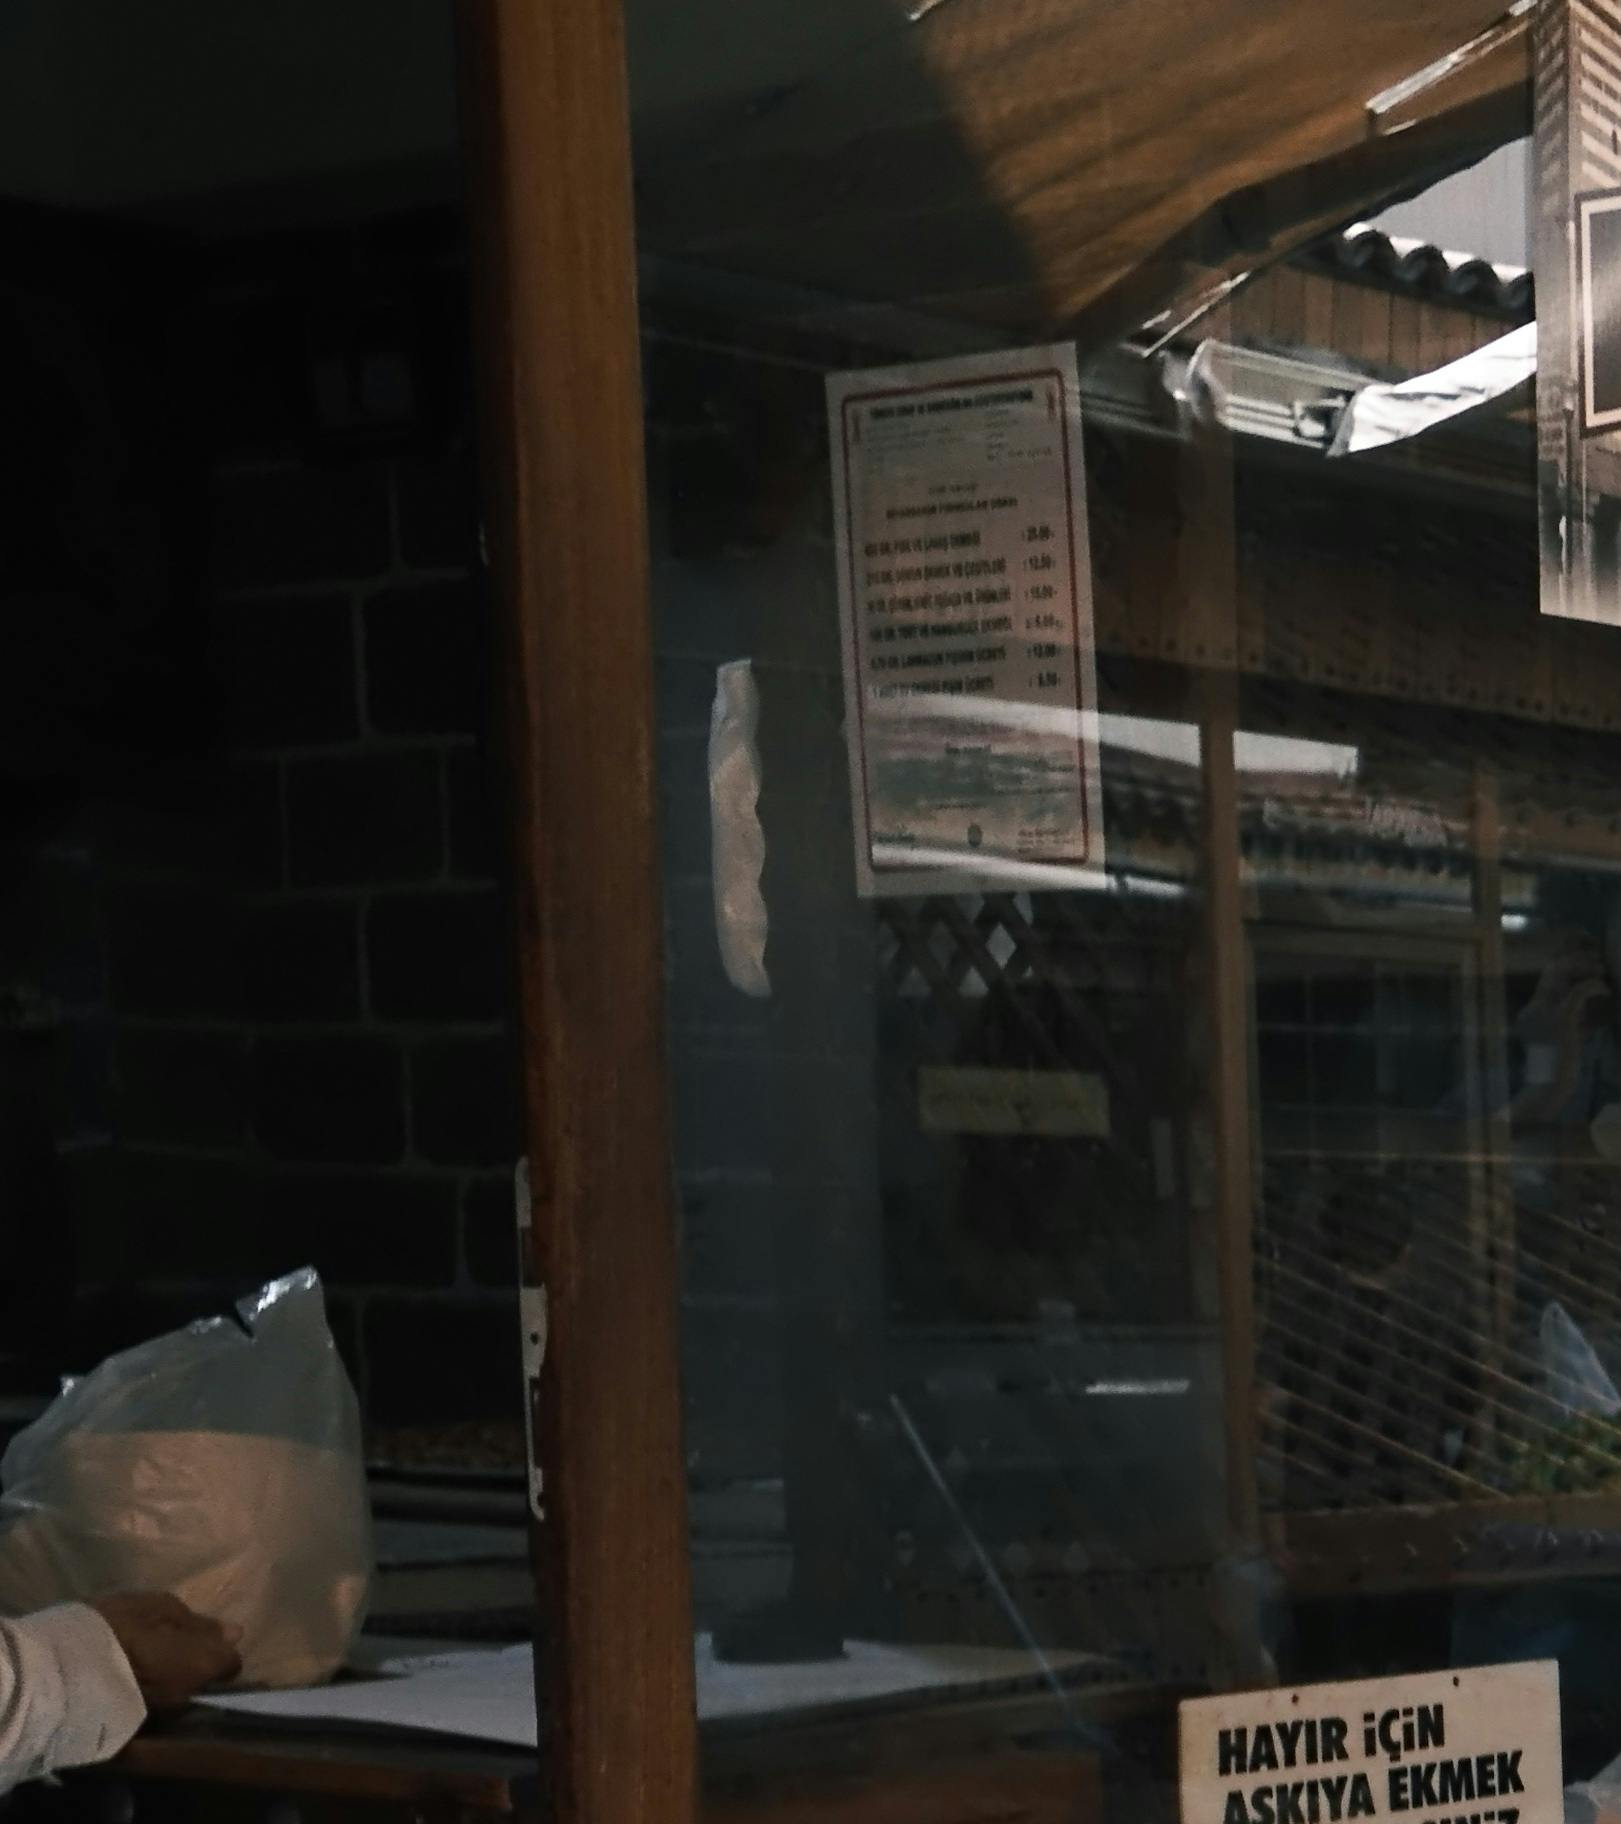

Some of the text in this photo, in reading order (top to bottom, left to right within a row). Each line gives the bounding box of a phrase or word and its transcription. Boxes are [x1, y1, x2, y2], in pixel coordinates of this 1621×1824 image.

[1218, 1703, 1446, 1776] HAYIR İÇİN
[1388, 1750, 1525, 1813] EKMEK
